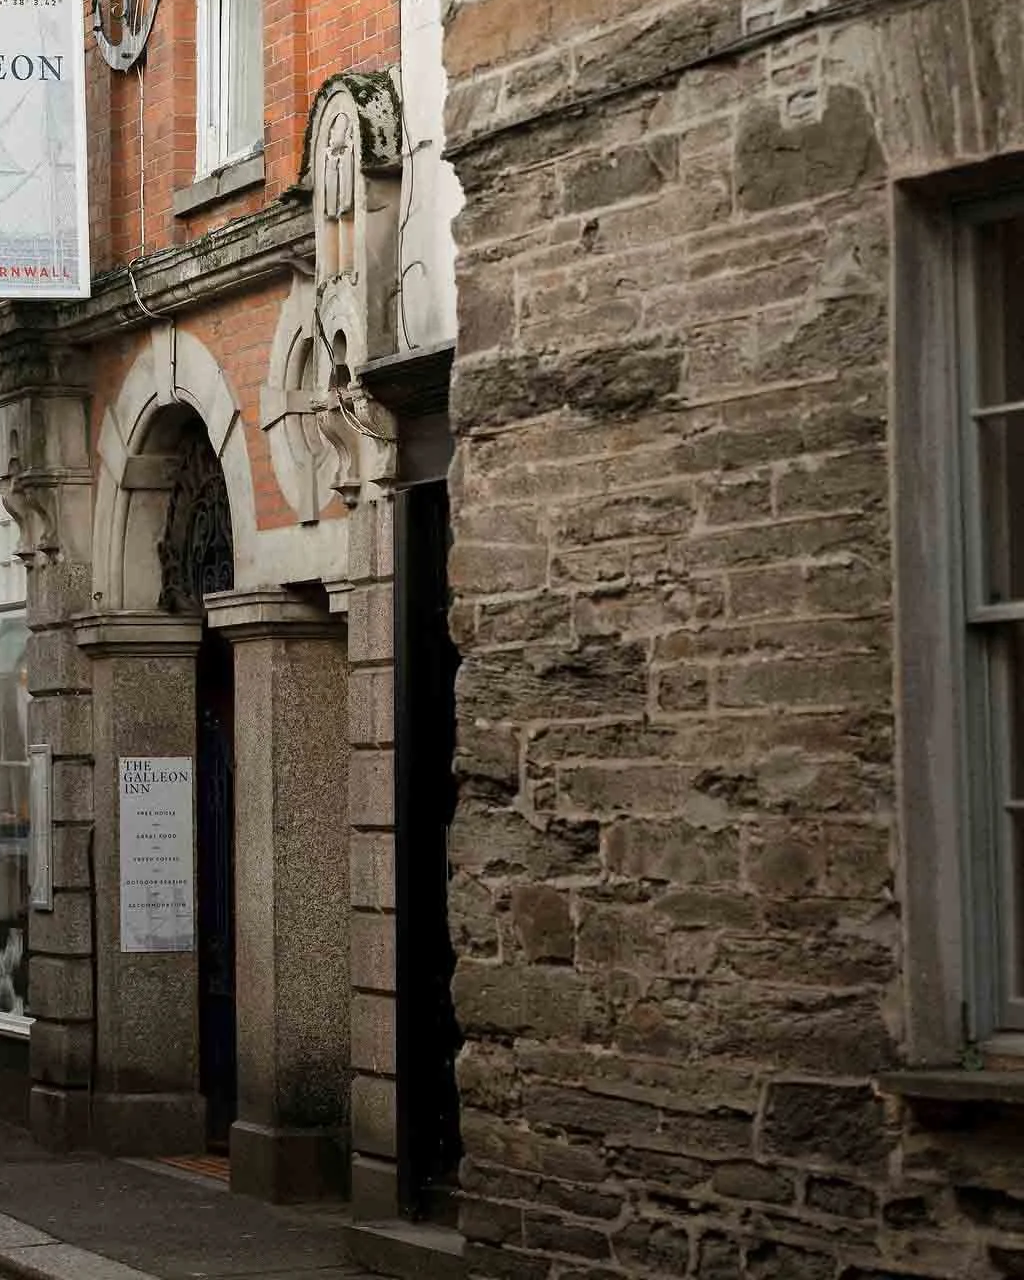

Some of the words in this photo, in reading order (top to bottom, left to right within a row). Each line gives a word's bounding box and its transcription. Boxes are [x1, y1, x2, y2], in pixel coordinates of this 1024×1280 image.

[123, 760, 152, 771] THE
[123, 771, 188, 783] GALLEON
[125, 783, 151, 794] INN
